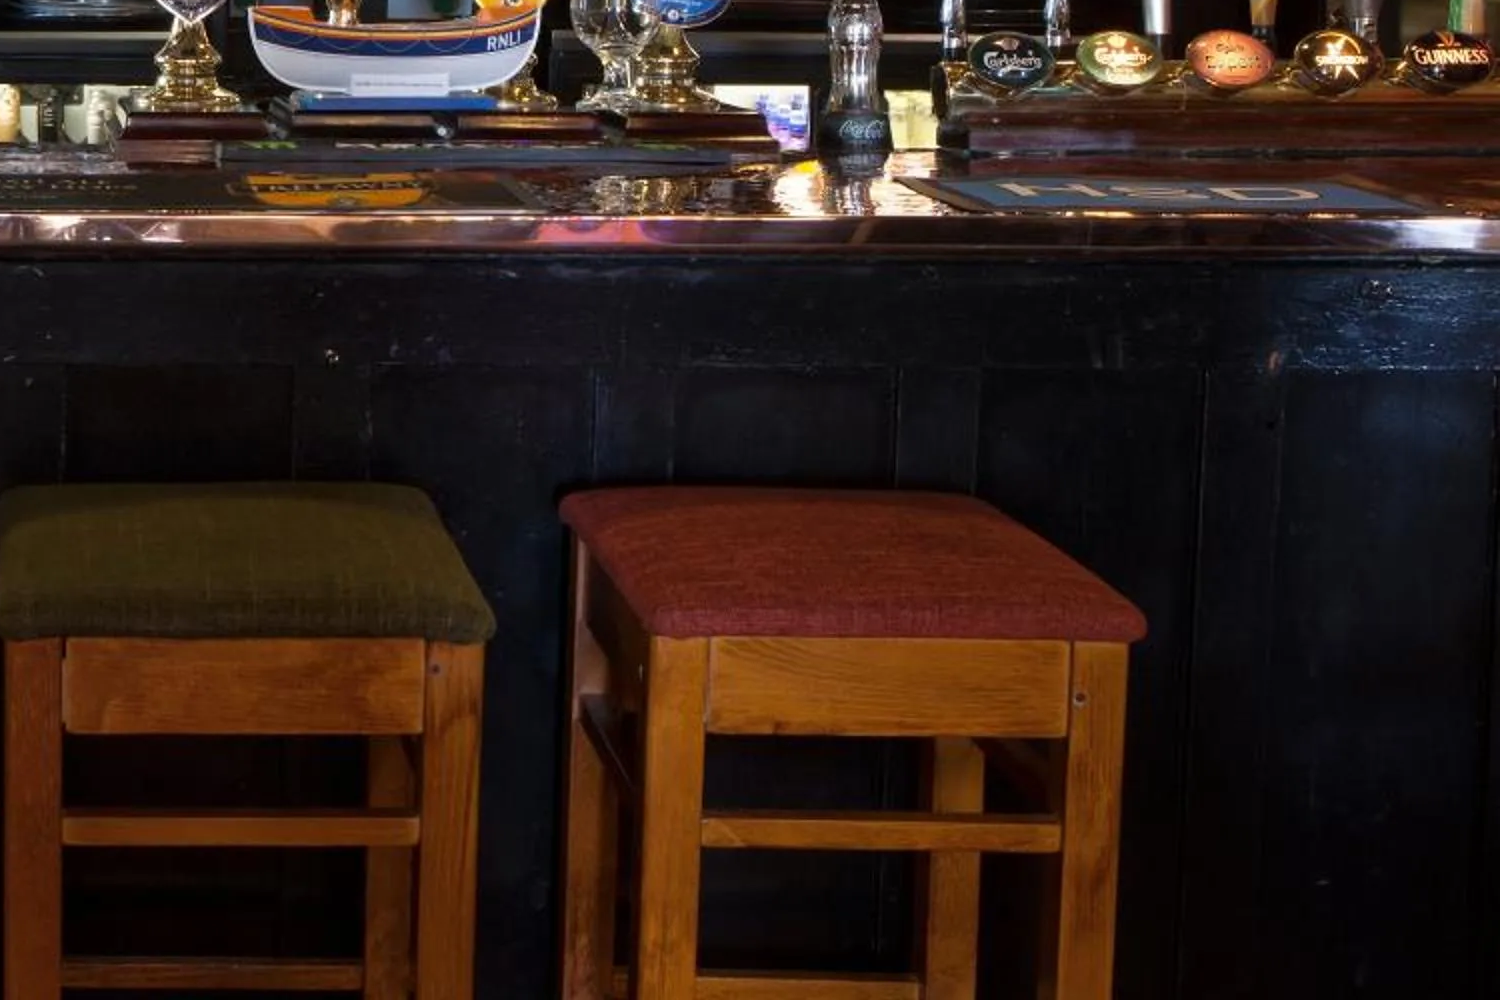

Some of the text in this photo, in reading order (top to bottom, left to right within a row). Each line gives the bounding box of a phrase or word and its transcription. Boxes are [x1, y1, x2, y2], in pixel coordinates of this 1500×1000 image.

[487, 31, 521, 52] RNLI
[983, 50, 1043, 73] Carlsberg
[1094, 46, 1154, 69] Carlsberg
[1413, 47, 1490, 66] GUINNESS
[995, 181, 1321, 203] HSD
